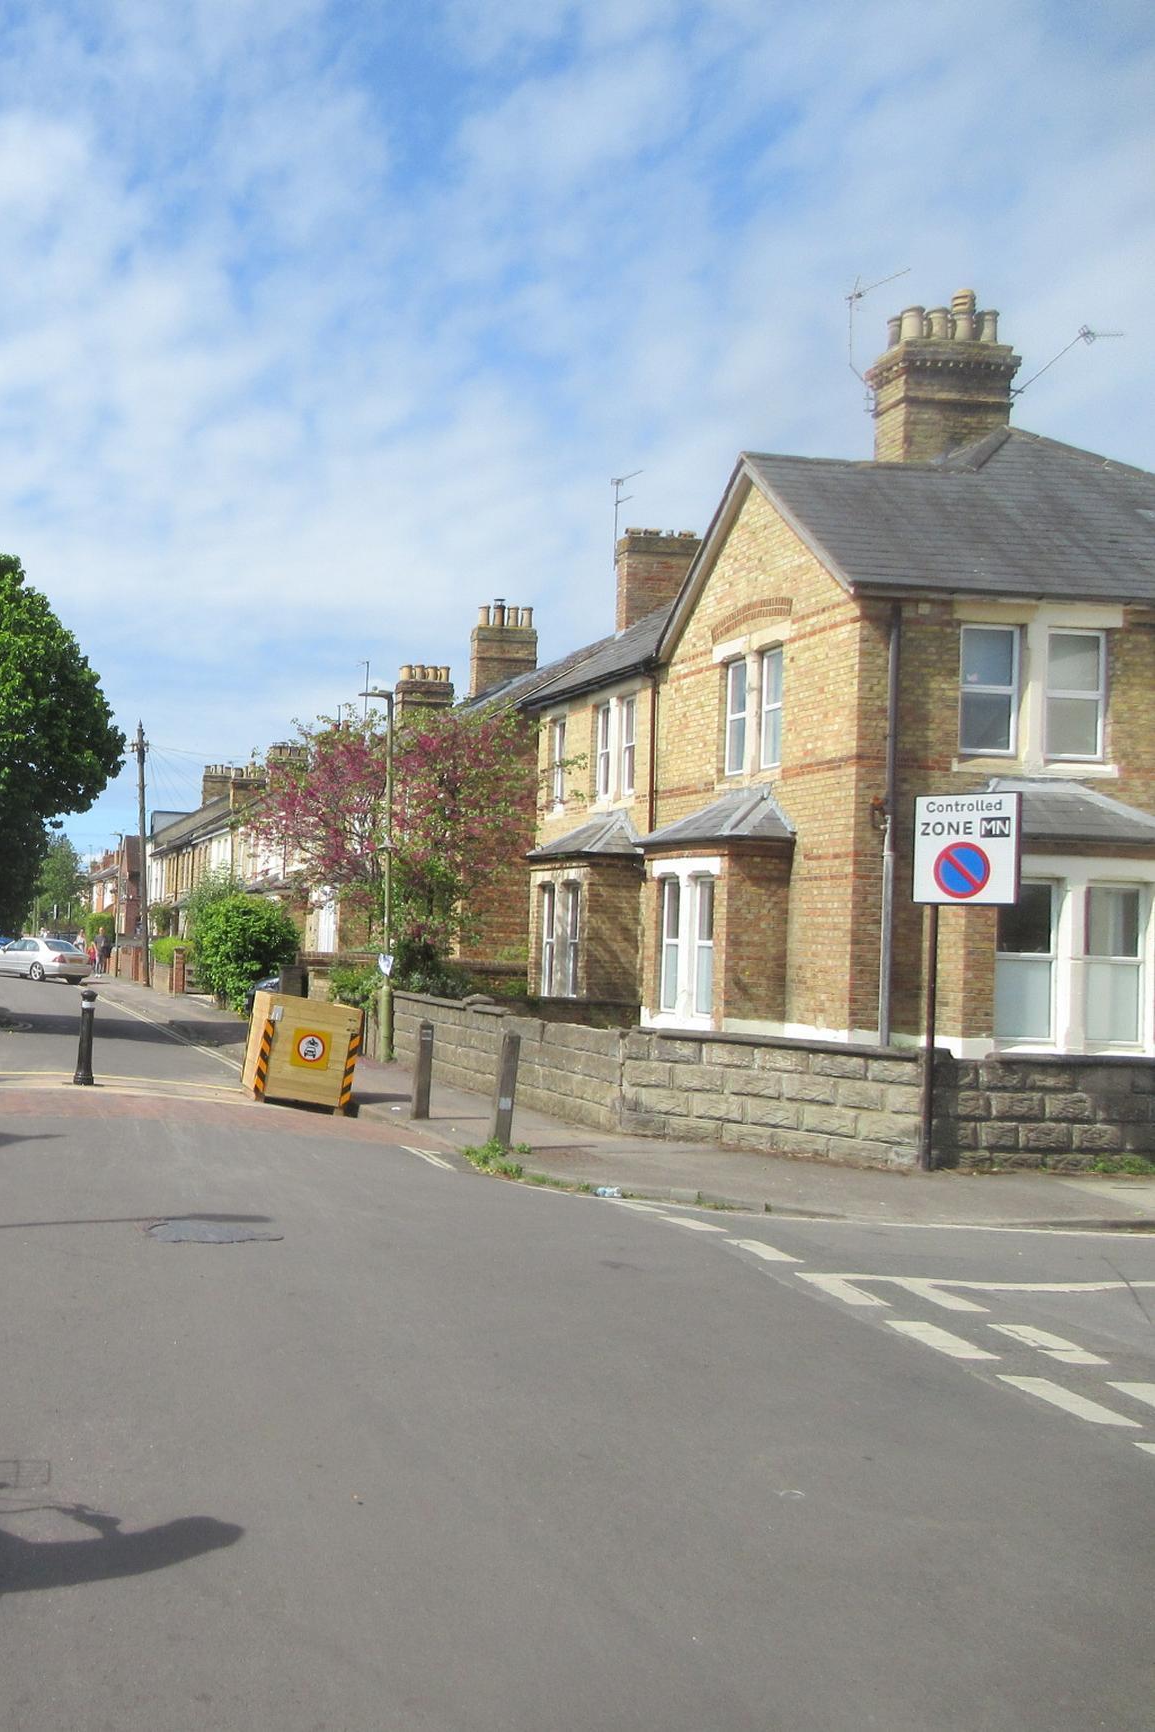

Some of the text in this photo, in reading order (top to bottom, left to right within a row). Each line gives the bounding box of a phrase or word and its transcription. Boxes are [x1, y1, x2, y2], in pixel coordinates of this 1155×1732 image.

[926, 799, 1003, 813] Controlled
[920, 820, 1009, 836] ZONE MN
